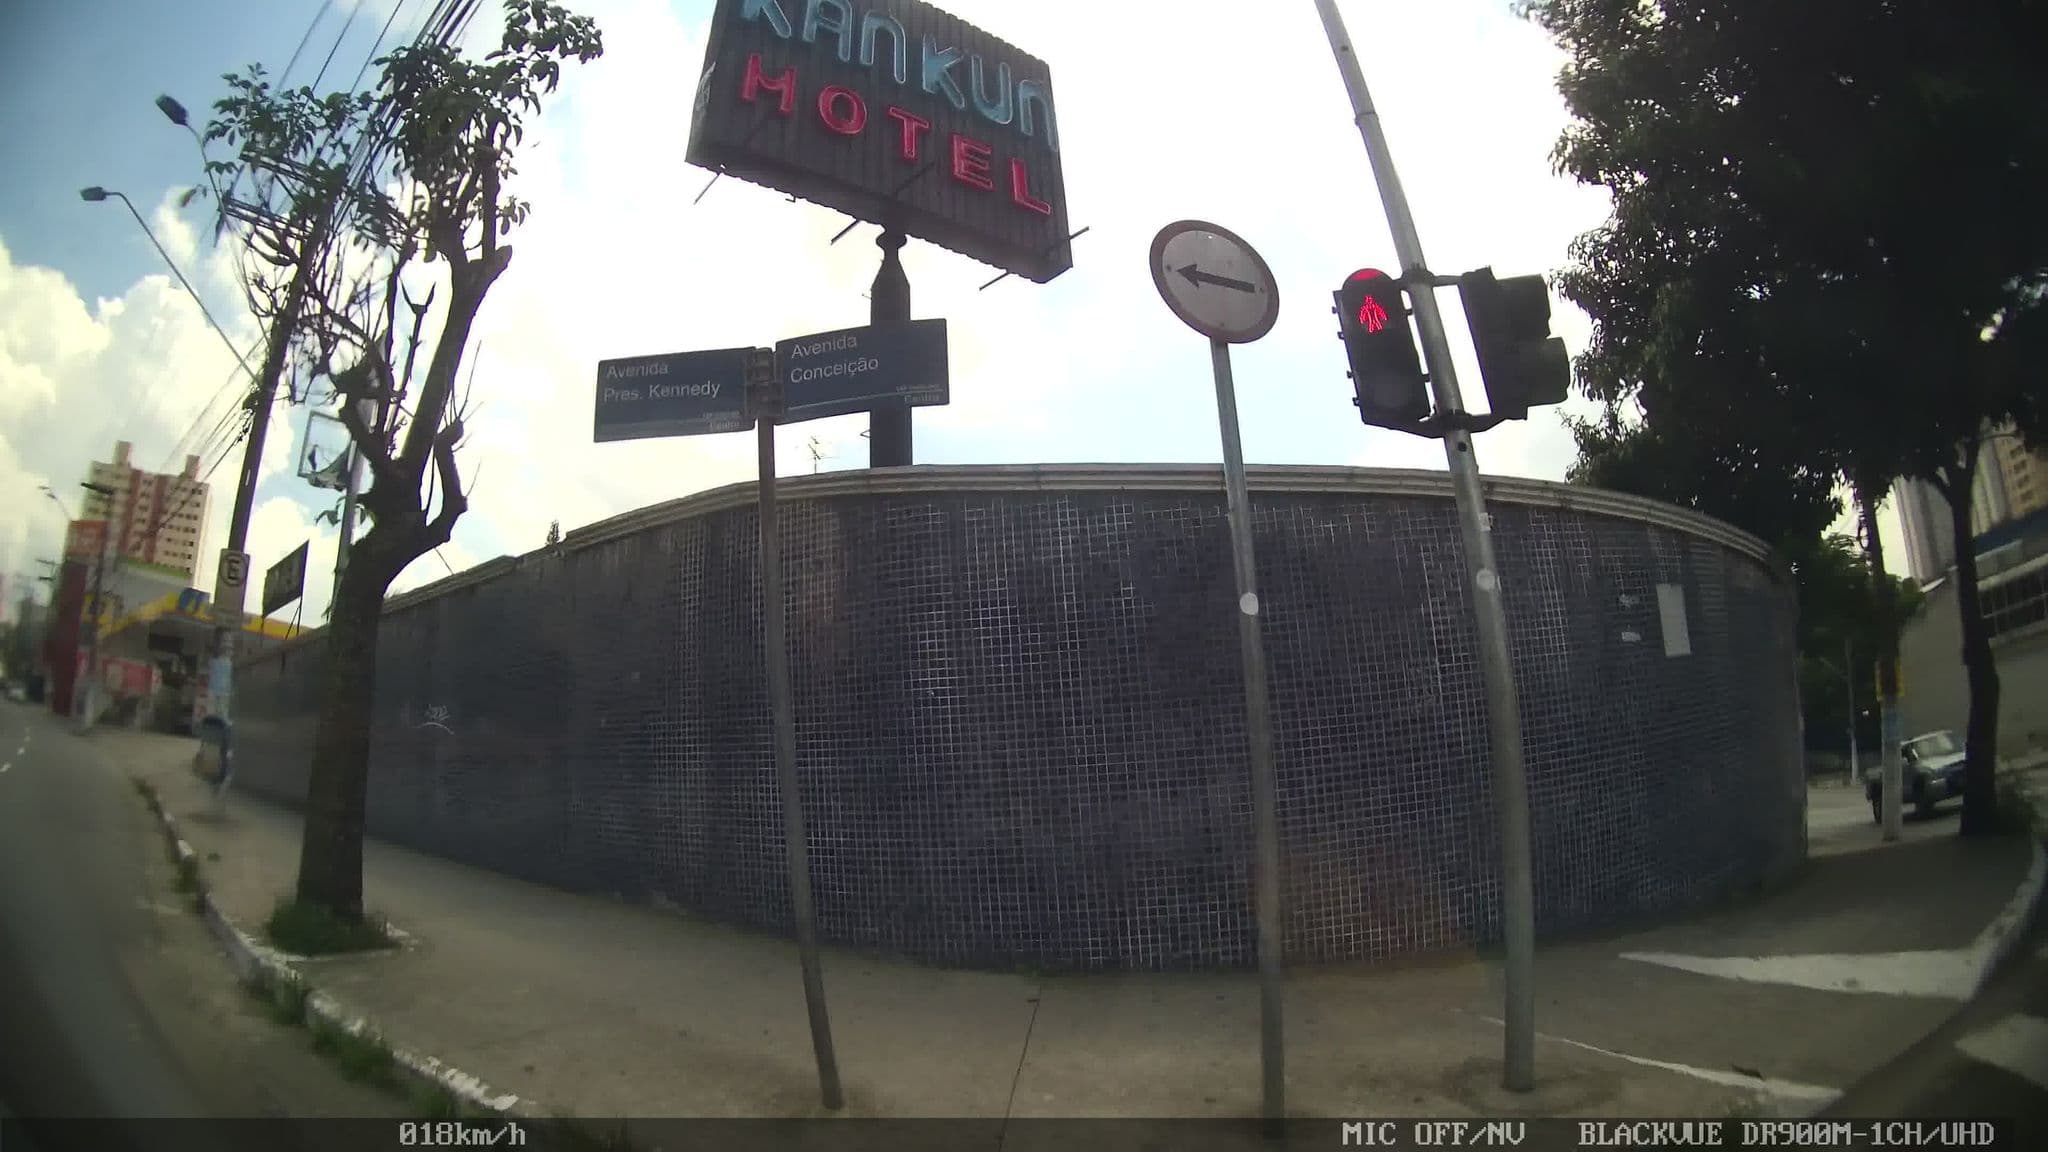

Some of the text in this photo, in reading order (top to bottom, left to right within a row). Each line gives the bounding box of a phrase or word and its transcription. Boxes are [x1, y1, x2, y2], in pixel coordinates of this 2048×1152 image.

[741, 53, 1052, 215] MOTEL
[791, 335, 858, 359] Avenida
[605, 361, 669, 379] Avenida
[790, 356, 879, 383] Conceição
[603, 380, 721, 402] Pres. Kennedy
